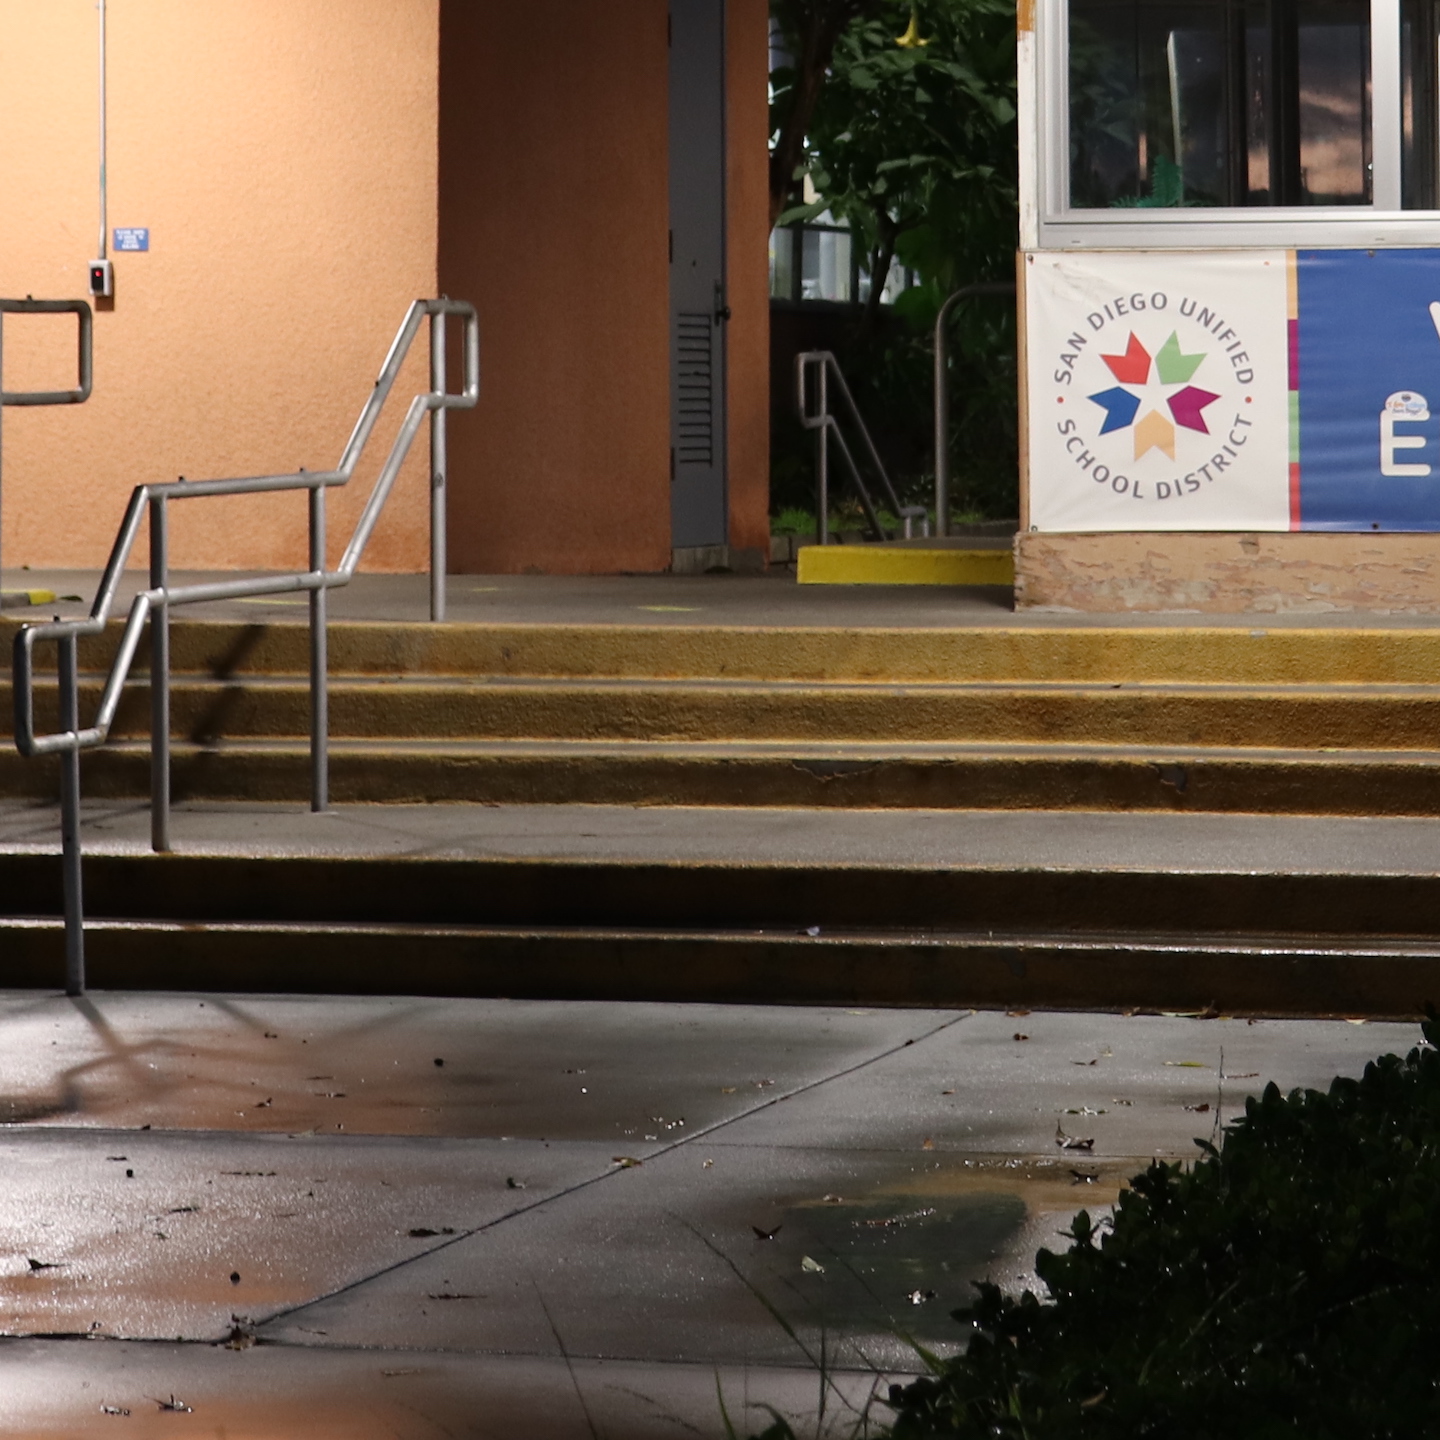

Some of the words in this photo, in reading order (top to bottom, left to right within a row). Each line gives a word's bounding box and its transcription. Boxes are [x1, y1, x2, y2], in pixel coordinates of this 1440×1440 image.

[1054, 332, 1088, 386] SAN
[1087, 292, 1168, 332] DIEGO
[1179, 297, 1254, 385] UNIFIED
[1057, 418, 1144, 500] SCHOOL
[1155, 413, 1252, 501] DISTRICT
